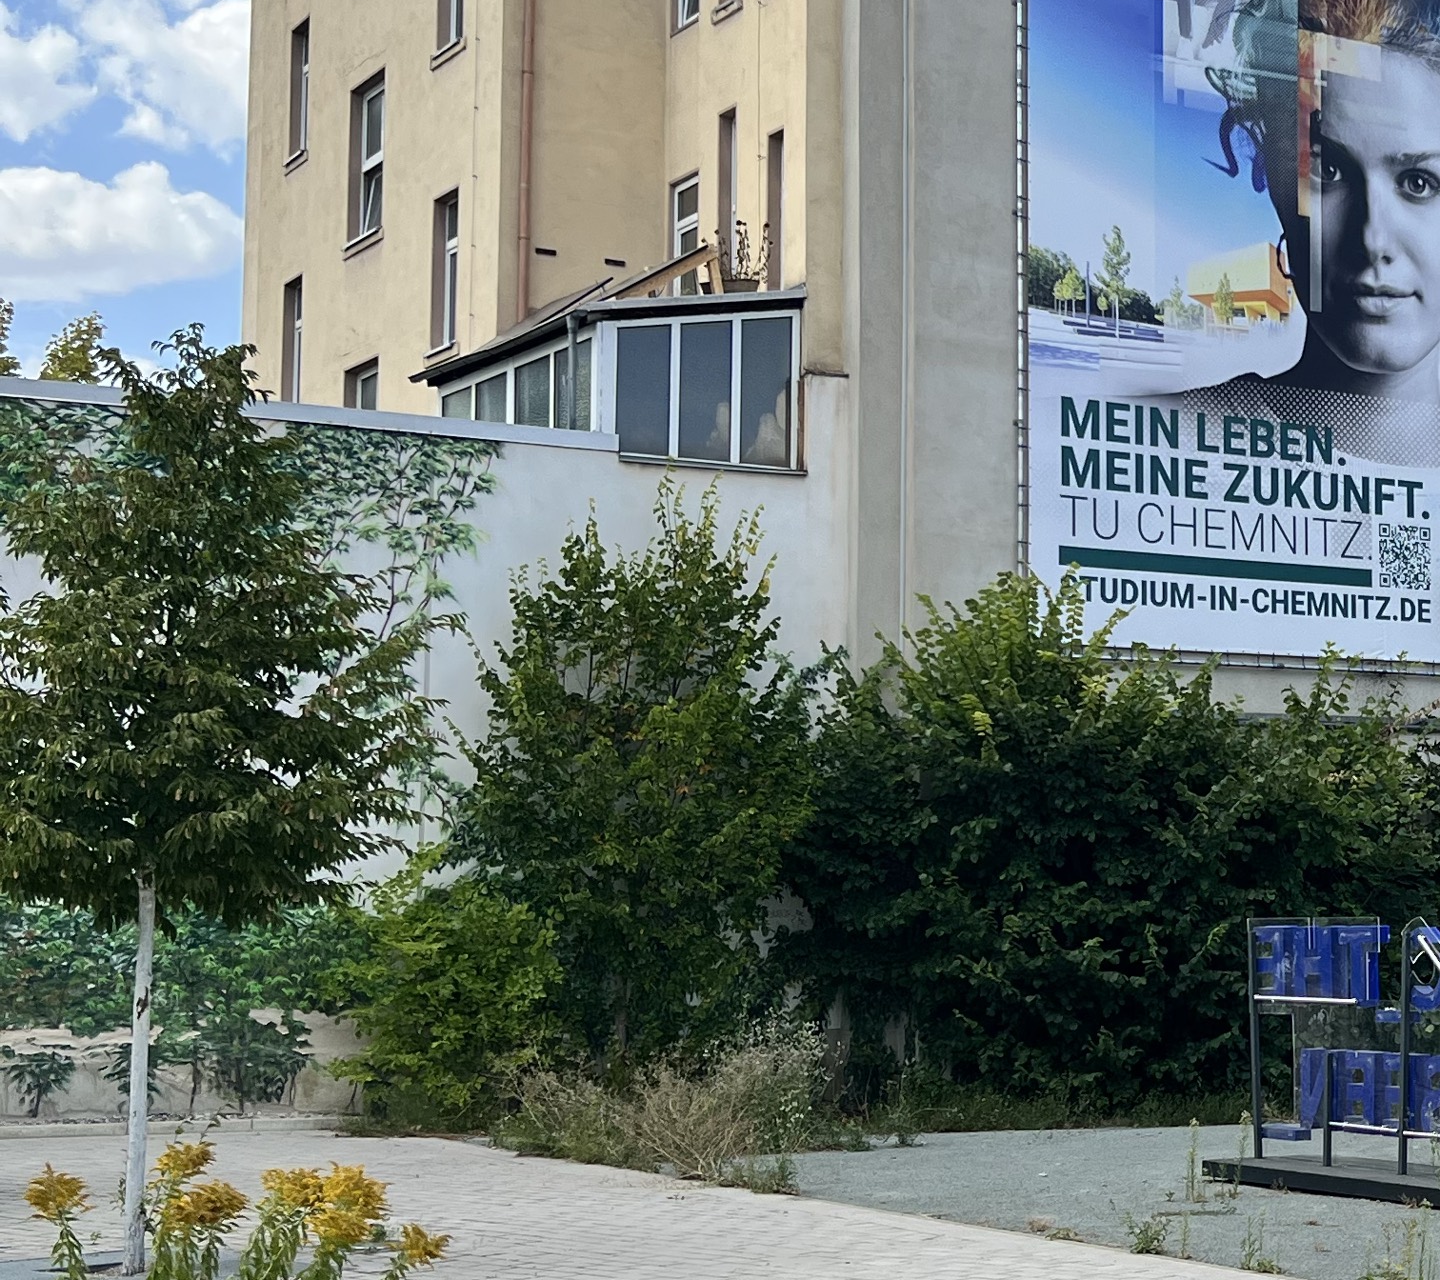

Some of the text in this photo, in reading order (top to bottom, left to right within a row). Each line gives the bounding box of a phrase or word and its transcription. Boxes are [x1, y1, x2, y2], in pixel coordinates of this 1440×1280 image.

[1060, 395, 1347, 467] MEIN LEBEN.
[1060, 445, 1430, 520] MEINE ZUKUNFT.
[1059, 494, 1373, 561] TU CHEMNITZ.
